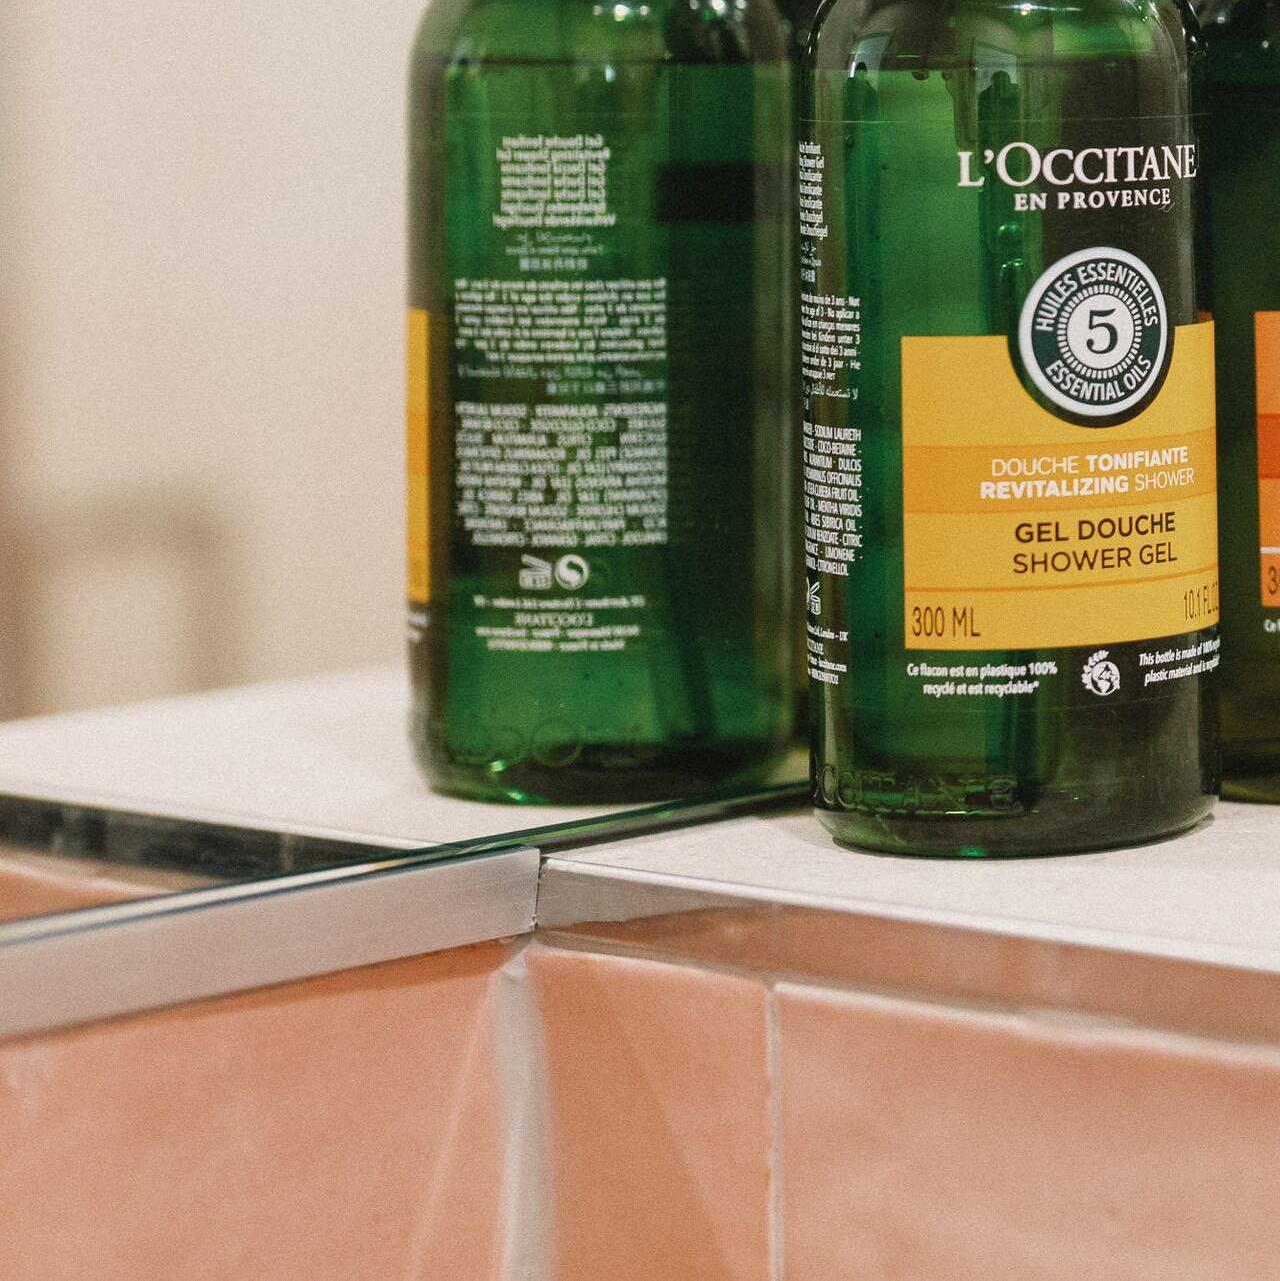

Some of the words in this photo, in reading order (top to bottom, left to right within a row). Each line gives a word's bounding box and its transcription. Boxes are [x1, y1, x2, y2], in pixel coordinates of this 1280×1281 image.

[957, 142, 1197, 187] L'OCCITANE
[1014, 193, 1047, 211] EN
[1057, 188, 1171, 210] PROVENCE
[1035, 273, 1078, 331] HUILES
[1076, 262, 1158, 327] ESSENTIELLES
[1086, 308, 1118, 354] 5
[1045, 360, 1125, 401] ESSENTIAL
[1123, 355, 1151, 390] OILS
[833, 428, 862, 441] LAURETH
[817, 441, 857, 457] COCO-BETAINE
[991, 455, 1079, 477] DOUCHE
[1085, 446, 1188, 473] TONIFIANTE
[838, 457, 862, 472] DULCIS
[980, 475, 1129, 500] REVITALIZING
[1134, 468, 1194, 492] SHOWER
[845, 518, 857, 532] OIL
[1015, 521, 1069, 543] GEL
[1077, 511, 1176, 540] DOUCHE
[842, 532, 863, 547] CITRIC
[1012, 547, 1131, 574] SHOWER
[1139, 542, 1178, 565] GEL
[1183, 588, 1200, 620] 10.1
[912, 606, 945, 637] 300
[952, 606, 981, 638] ML
[1139, 652, 1155, 667] This
[1155, 649, 1176, 665] bottle
[1175, 648, 1182, 661] is
[1181, 644, 1197, 660] made
[906, 663, 919, 676] Ce
[919, 662, 948, 677] flacon
[949, 664, 965, 677] est
[965, 665, 979, 677] en
[980, 663, 1027, 681] plastique
[1028, 661, 1058, 675] 100%
[1144, 669, 1169, 687] plastic
[1168, 662, 1193, 680] material
[922, 682, 955, 699] recyclé
[956, 682, 967, 695] et
[967, 683, 984, 695] est
